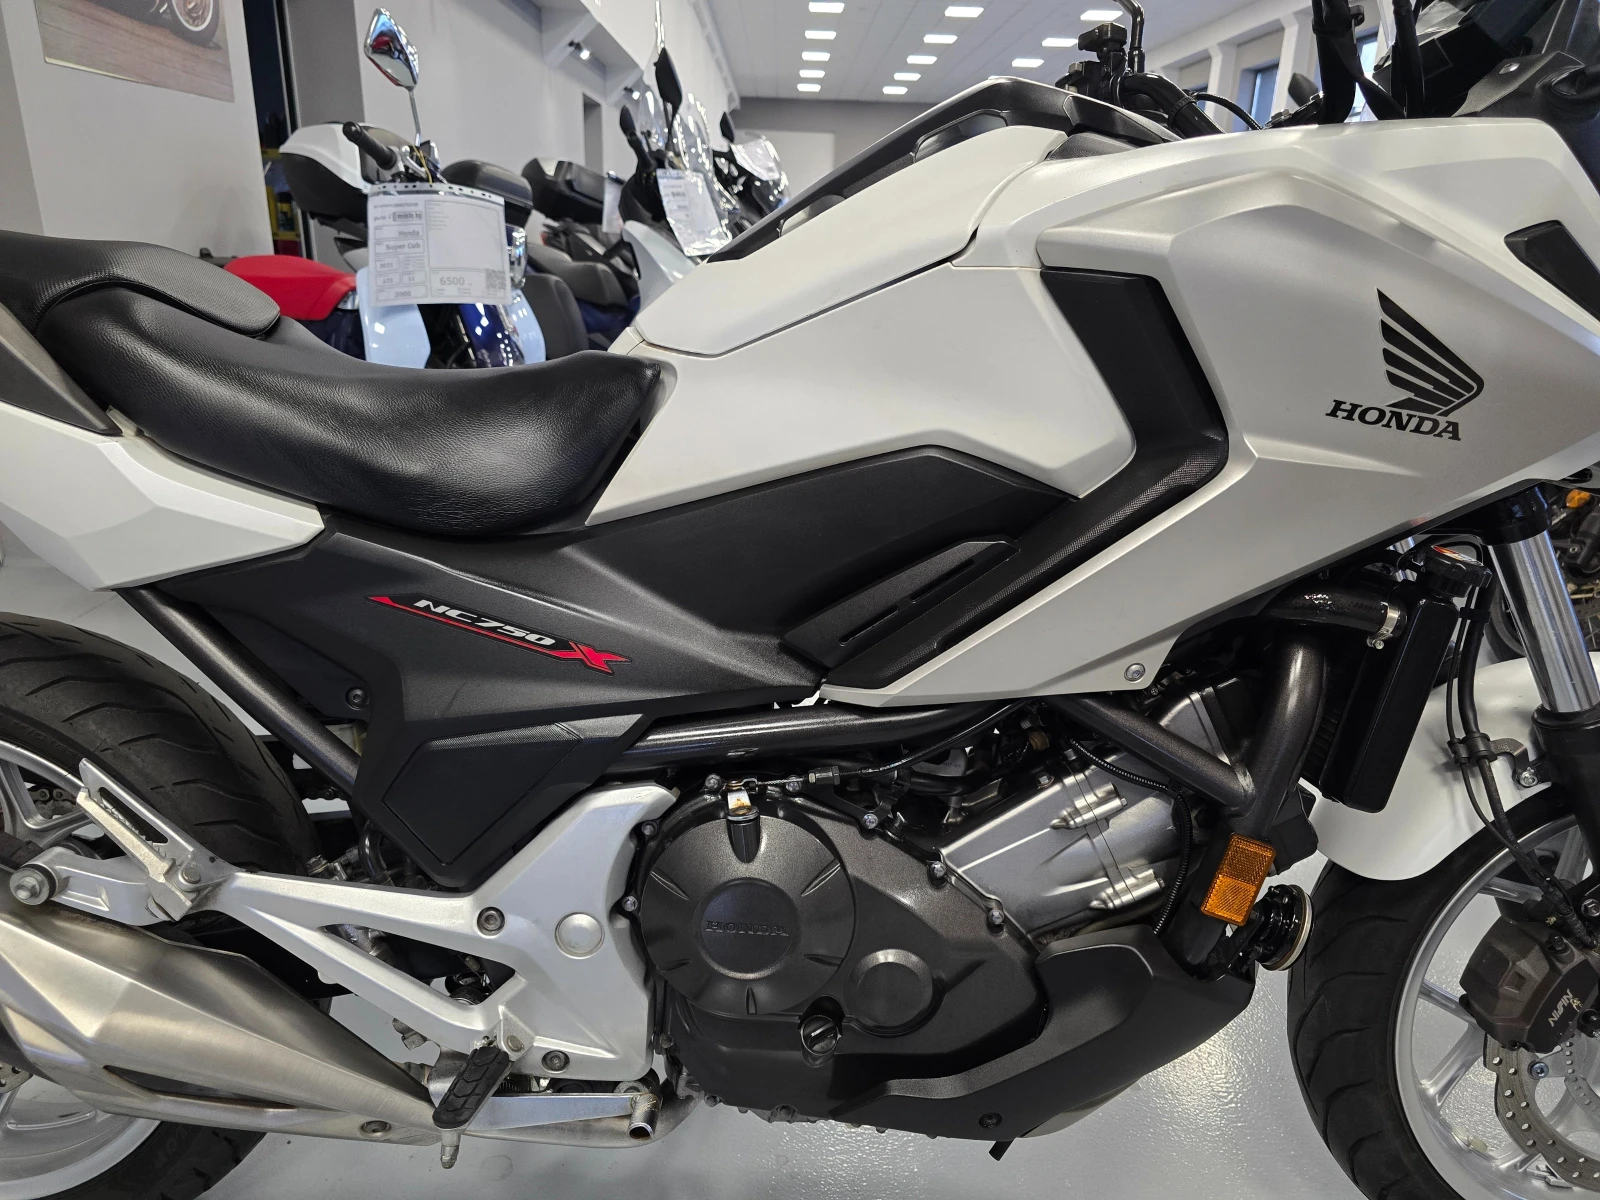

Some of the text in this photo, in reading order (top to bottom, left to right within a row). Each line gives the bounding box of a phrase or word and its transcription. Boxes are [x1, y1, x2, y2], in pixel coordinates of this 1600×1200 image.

[399, 229, 420, 237] Honda
[386, 242, 421, 252] Super Cub
[439, 276, 466, 286] 6500
[1325, 399, 1462, 441] HONDA
[705, 920, 789, 936] HONDA
